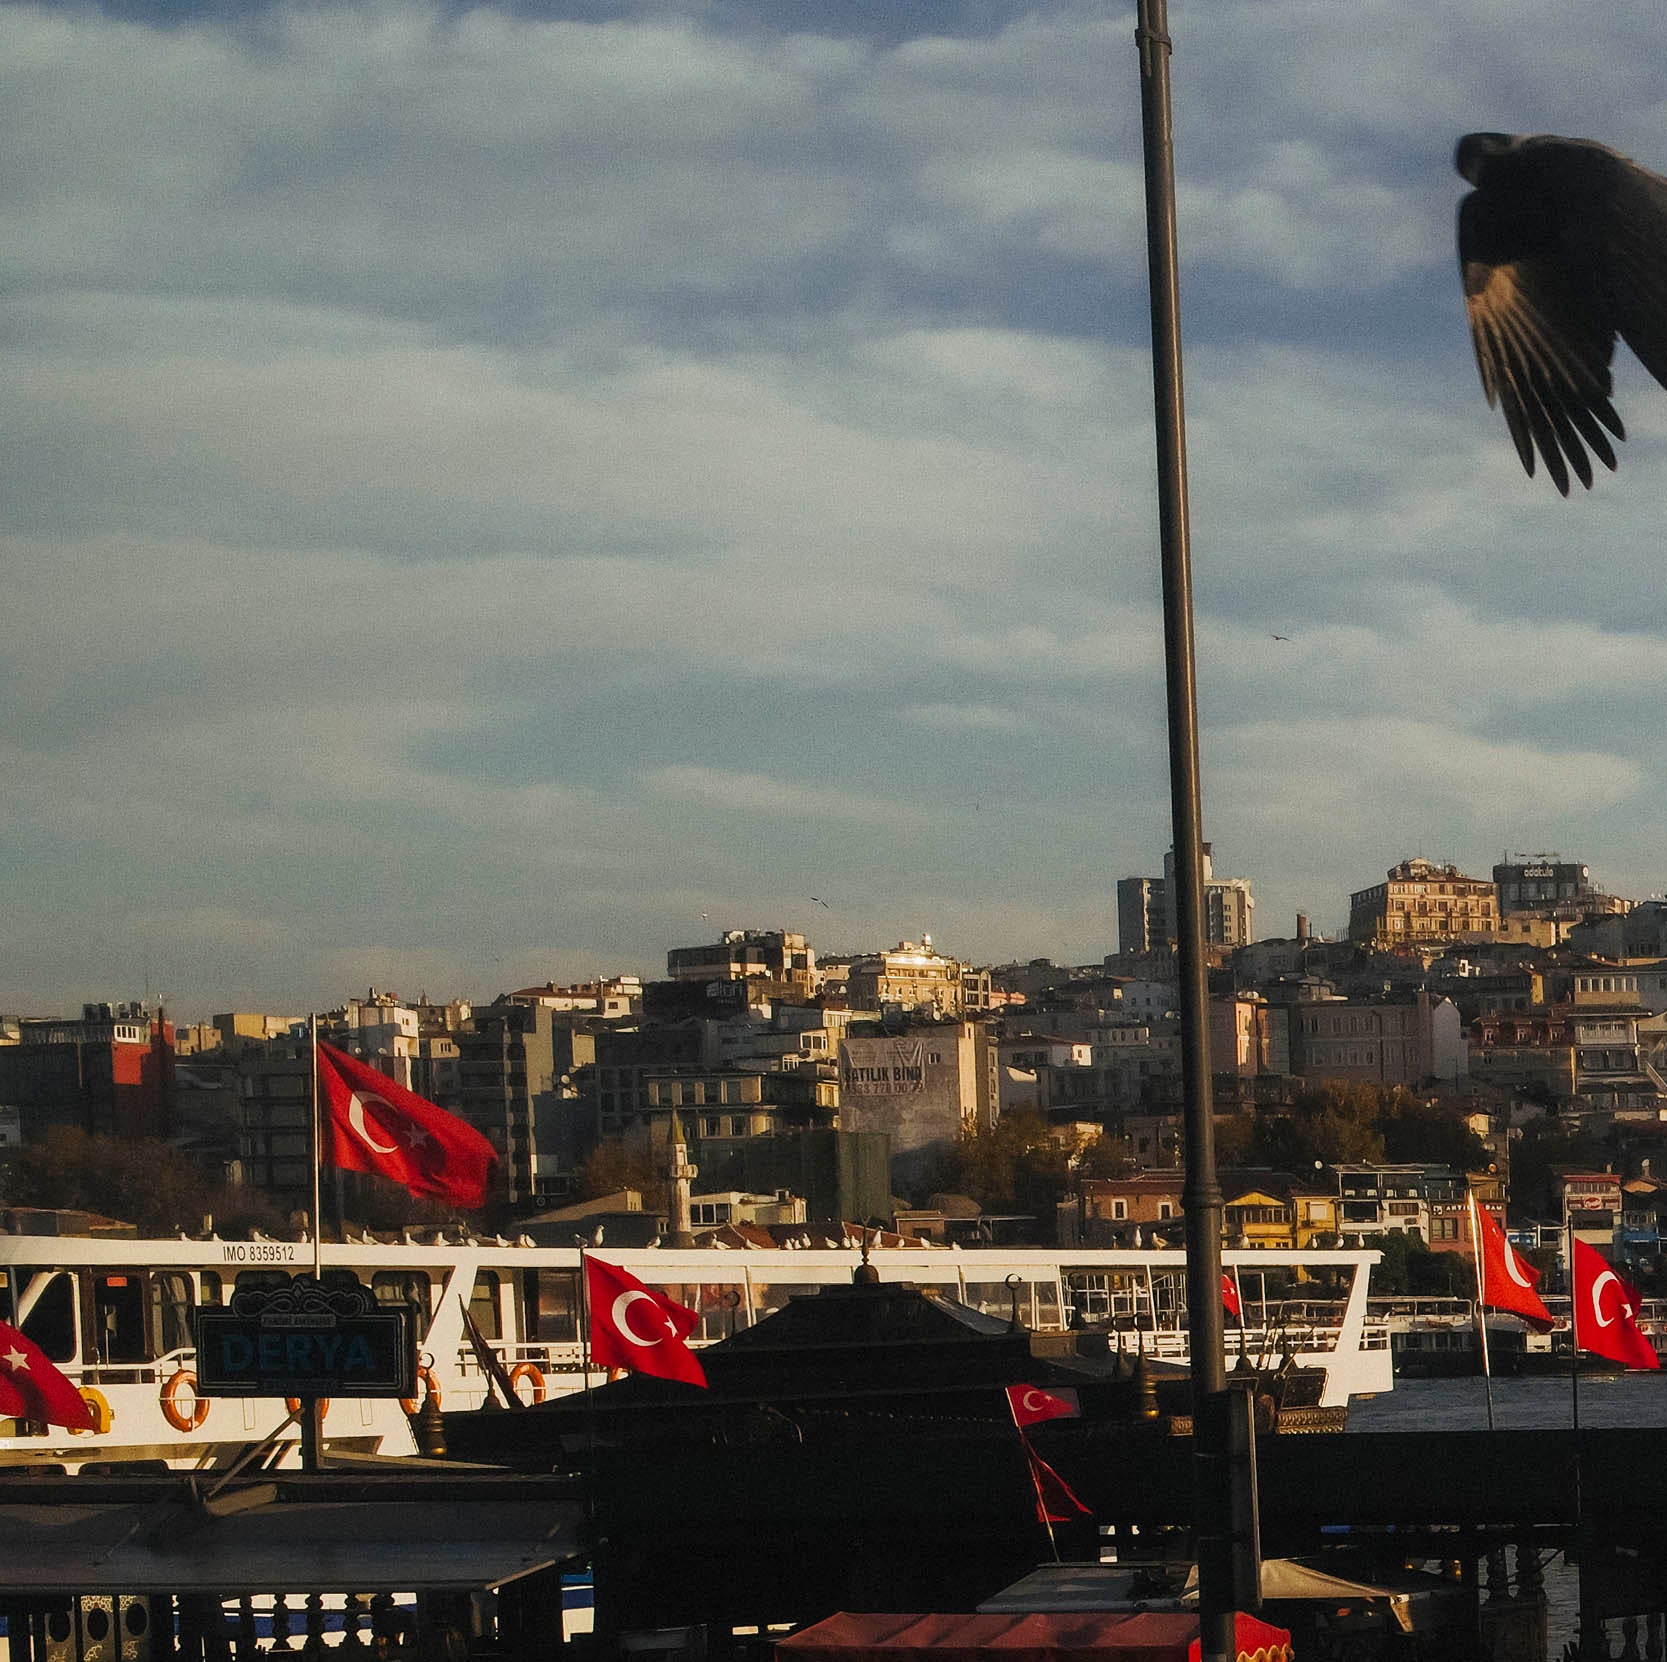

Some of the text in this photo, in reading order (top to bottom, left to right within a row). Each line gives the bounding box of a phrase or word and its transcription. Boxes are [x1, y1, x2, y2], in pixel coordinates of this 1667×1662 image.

[845, 1066, 889, 1082] SATILIK
[223, 1245, 295, 1261] IMO 8359512
[222, 1333, 376, 1372] DERYA
